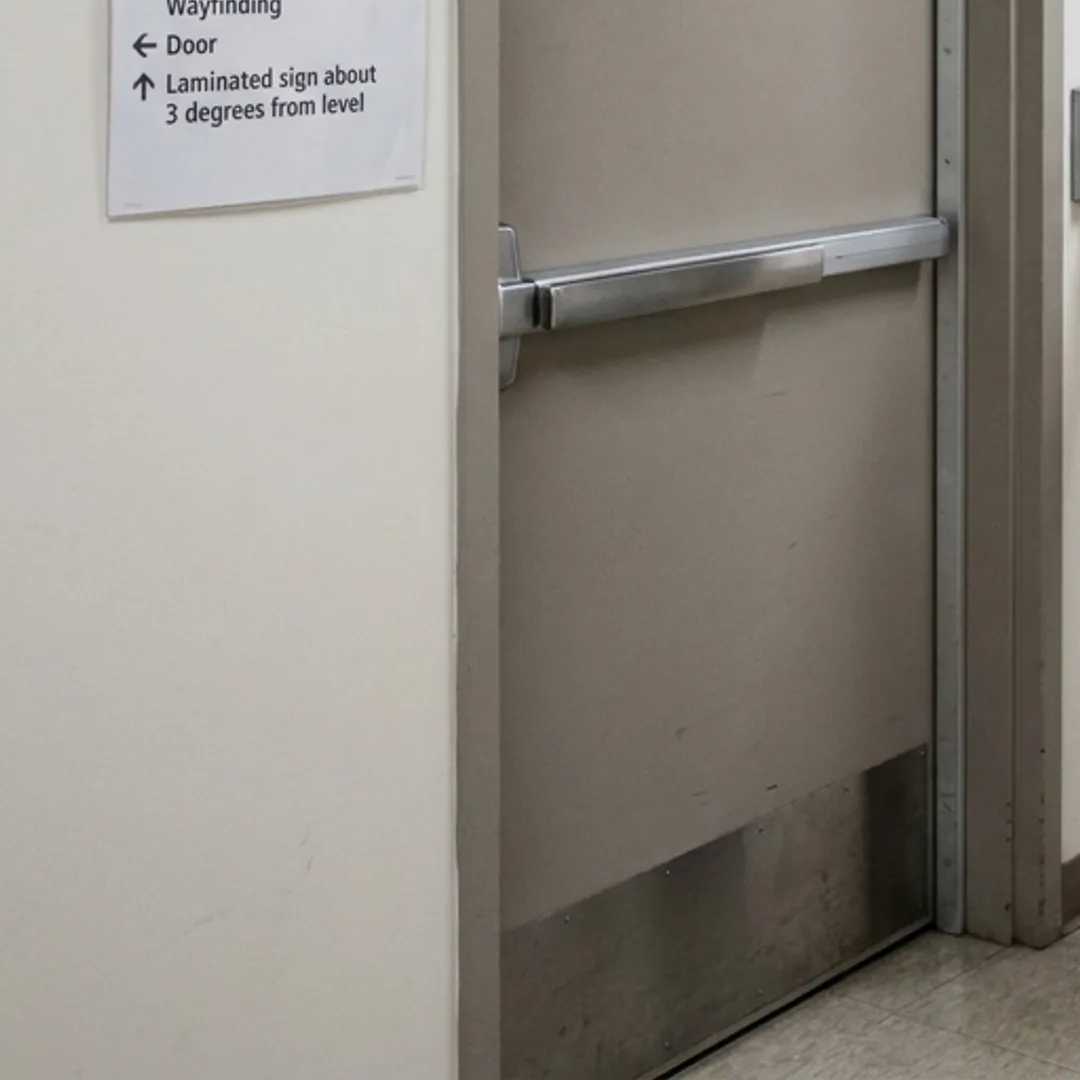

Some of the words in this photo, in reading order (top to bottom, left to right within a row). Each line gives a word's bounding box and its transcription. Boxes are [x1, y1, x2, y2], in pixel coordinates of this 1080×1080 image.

[167, 34, 217, 55] Door
[167, 68, 272, 94] Laminated
[280, 67, 317, 92] sign
[324, 65, 376, 85] about
[166, 103, 178, 125] 3
[185, 101, 264, 127] degrees
[271, 97, 315, 117] from
[323, 92, 364, 114] level
